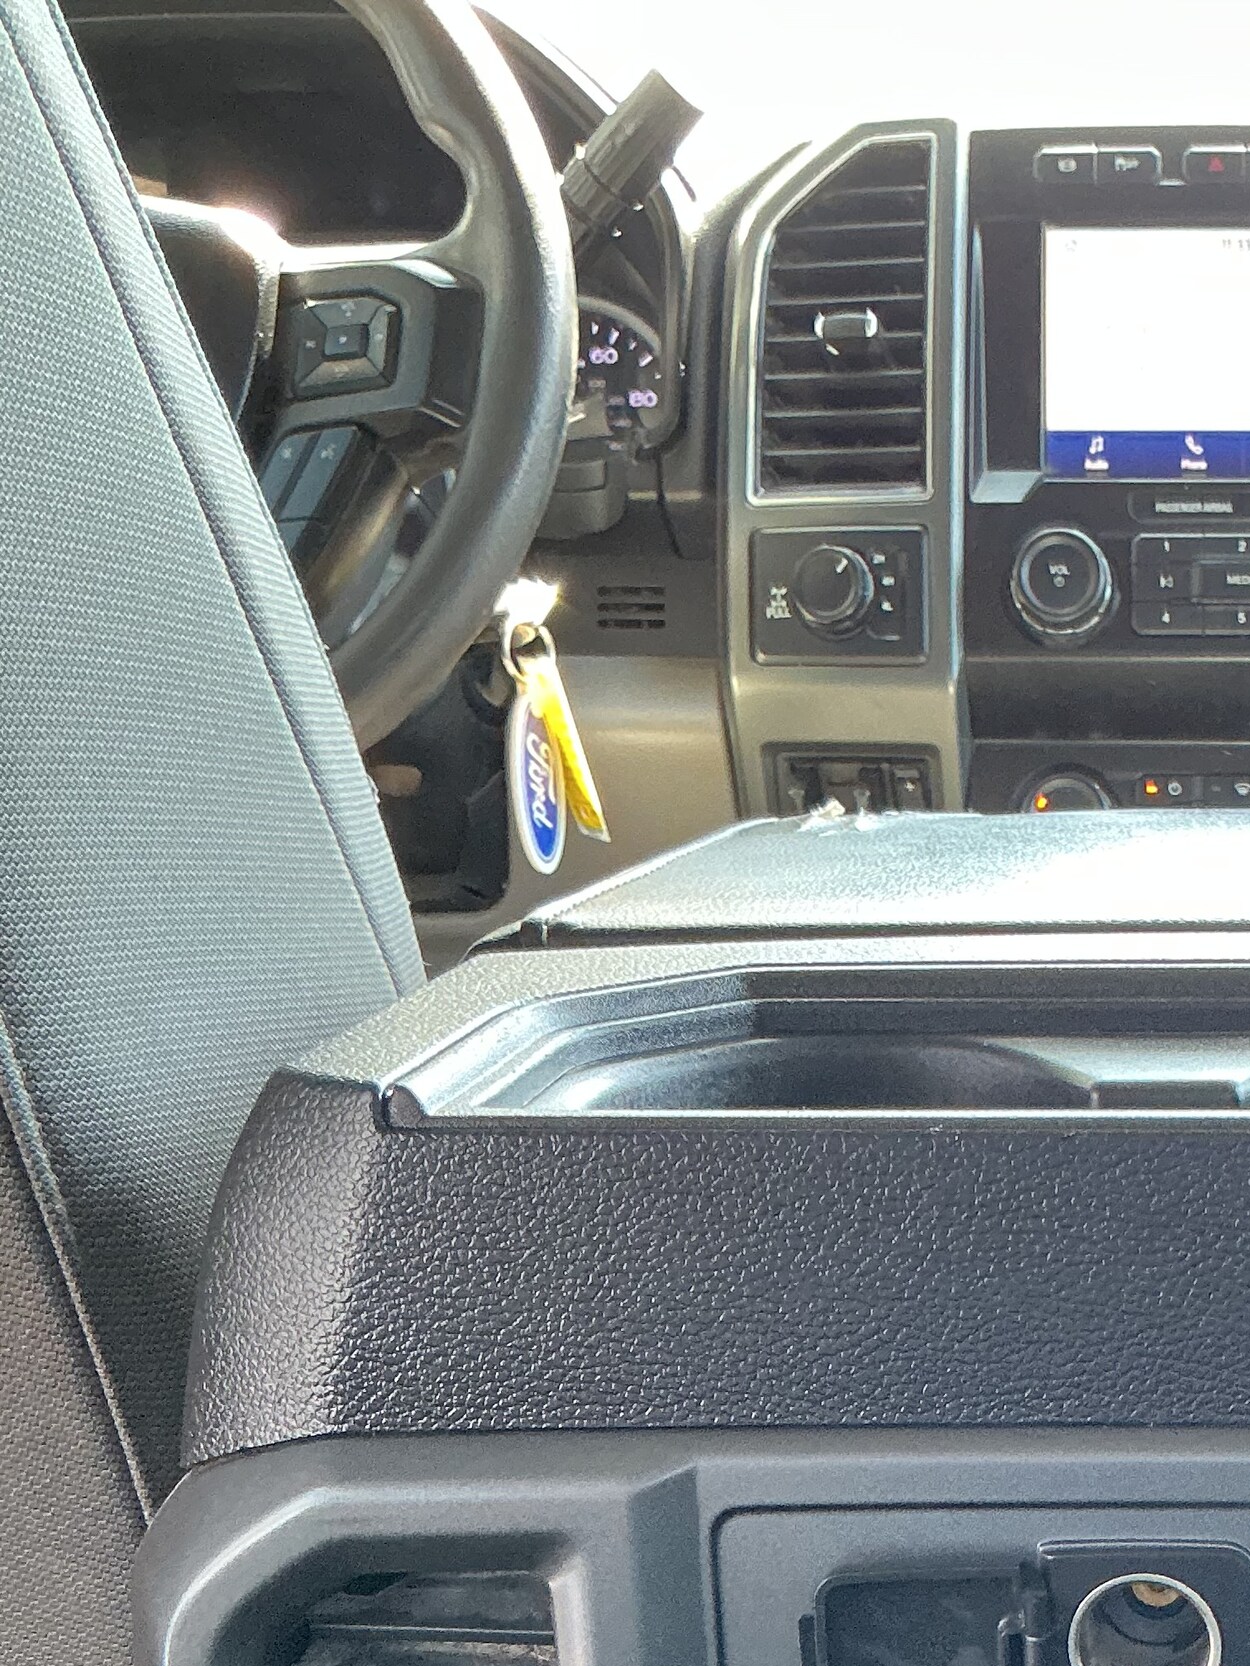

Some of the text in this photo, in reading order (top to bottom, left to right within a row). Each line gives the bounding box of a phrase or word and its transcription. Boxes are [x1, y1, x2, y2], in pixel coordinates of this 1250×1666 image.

[1238, 540, 1247, 553] 2
[1049, 563, 1071, 576] VOL
[1238, 610, 1247, 625] 5
[526, 731, 557, 830] Ford
